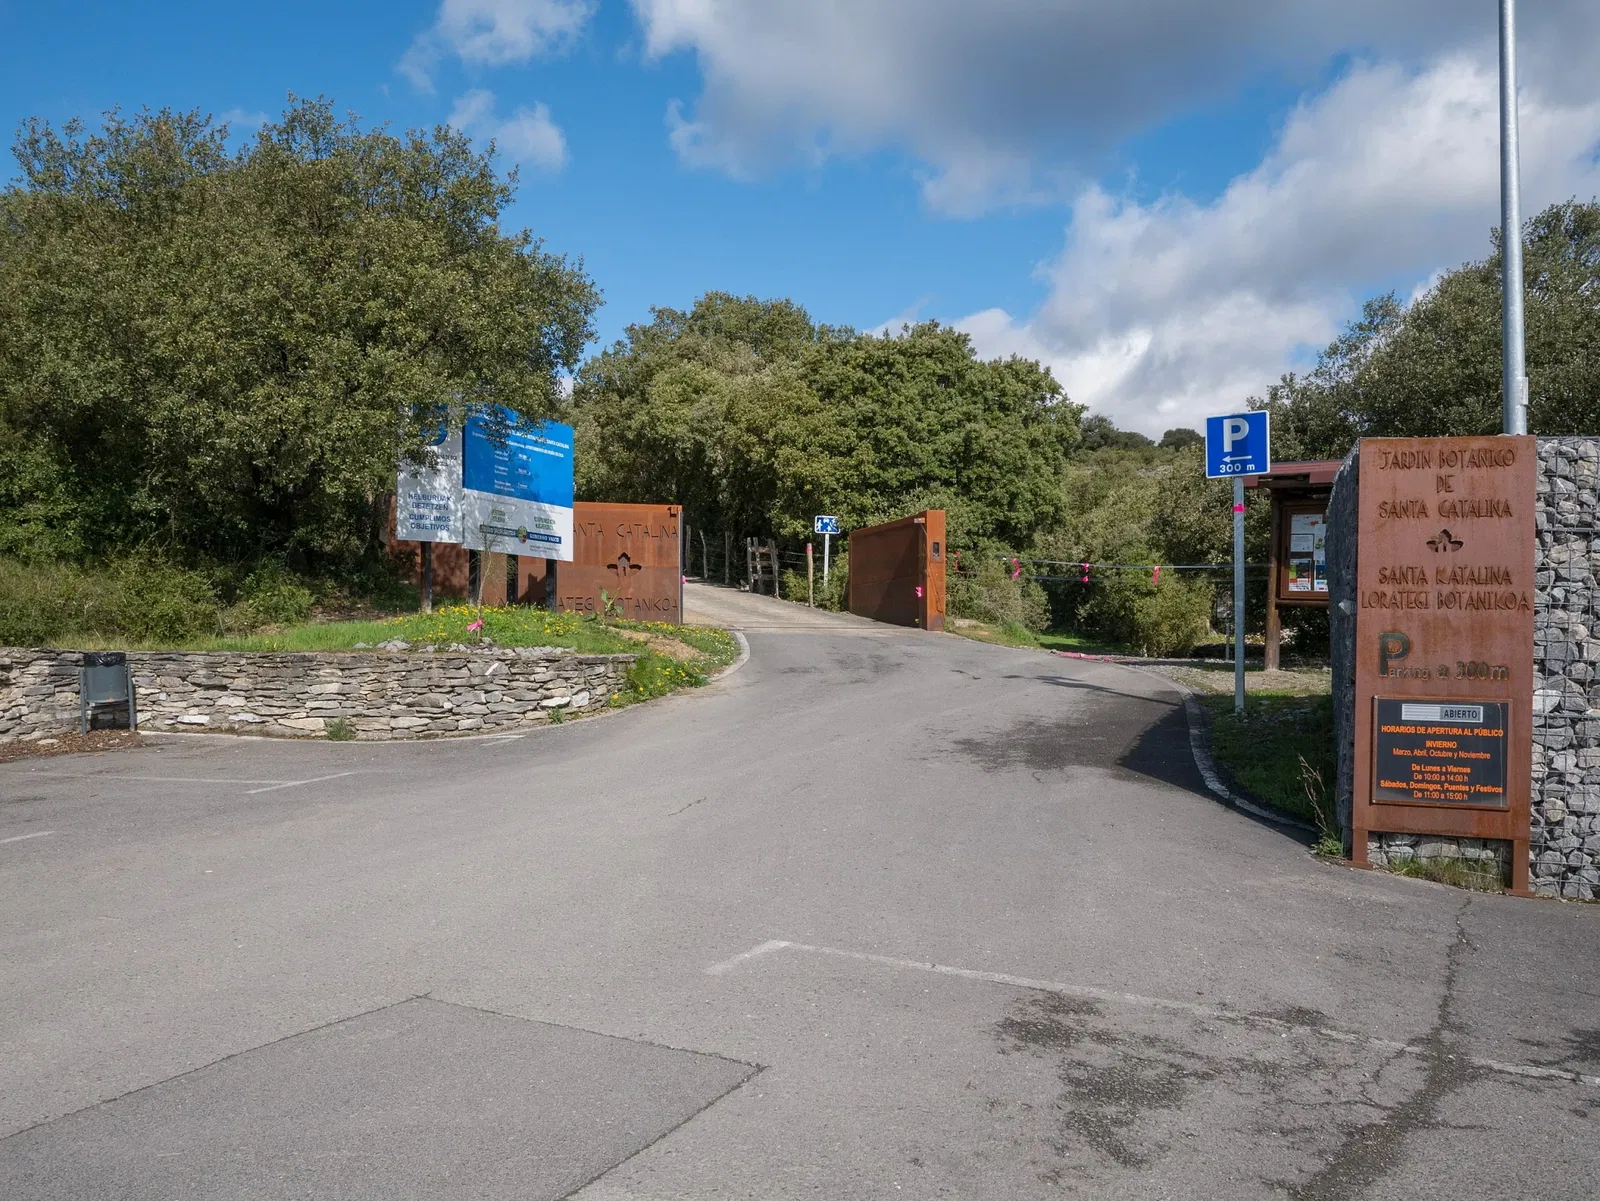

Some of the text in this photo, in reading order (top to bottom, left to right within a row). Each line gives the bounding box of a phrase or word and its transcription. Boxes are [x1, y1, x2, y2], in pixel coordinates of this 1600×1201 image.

[1223, 418, 1250, 453] P
[1220, 463, 1242, 473] 300
[1436, 474, 1455, 494] DE
[1378, 499, 1514, 518] SANTA CATALINA
[409, 514, 451, 522] CUMPLIMOS
[410, 522, 450, 531] OBJETIVOS
[573, 522, 605, 538] ANTA
[616, 523, 678, 538] CATALINA
[1378, 566, 1512, 585] SANTA KATALINA
[606, 597, 679, 612] OTANIKOA
[1362, 590, 1531, 610] LORATEGI BOTANIKOA
[1436, 664, 1448, 679] a
[1455, 661, 1508, 681] 300m
[1444, 710, 1478, 719] ABIERTO
[1381, 725, 1416, 734] HORARIOS
[1426, 727, 1462, 736] APERTURA
[1474, 728, 1504, 737] PÚBLICO
[1426, 740, 1458, 749] INVIERNO
[1392, 748, 1412, 756] Marzo,
[1413, 749, 1428, 757] Abril,
[1430, 750, 1453, 758] Octubre
[1458, 751, 1491, 760] Noviembre
[1422, 764, 1440, 772] Lunes
[1447, 765, 1471, 774] Viernes
[1380, 780, 1408, 789] Sábados,
[1410, 781, 1443, 791] Domingos,
[1444, 783, 1470, 792] Puentes
[1476, 784, 1503, 793] Festivos
[1446, 792, 1462, 800] 15:00
